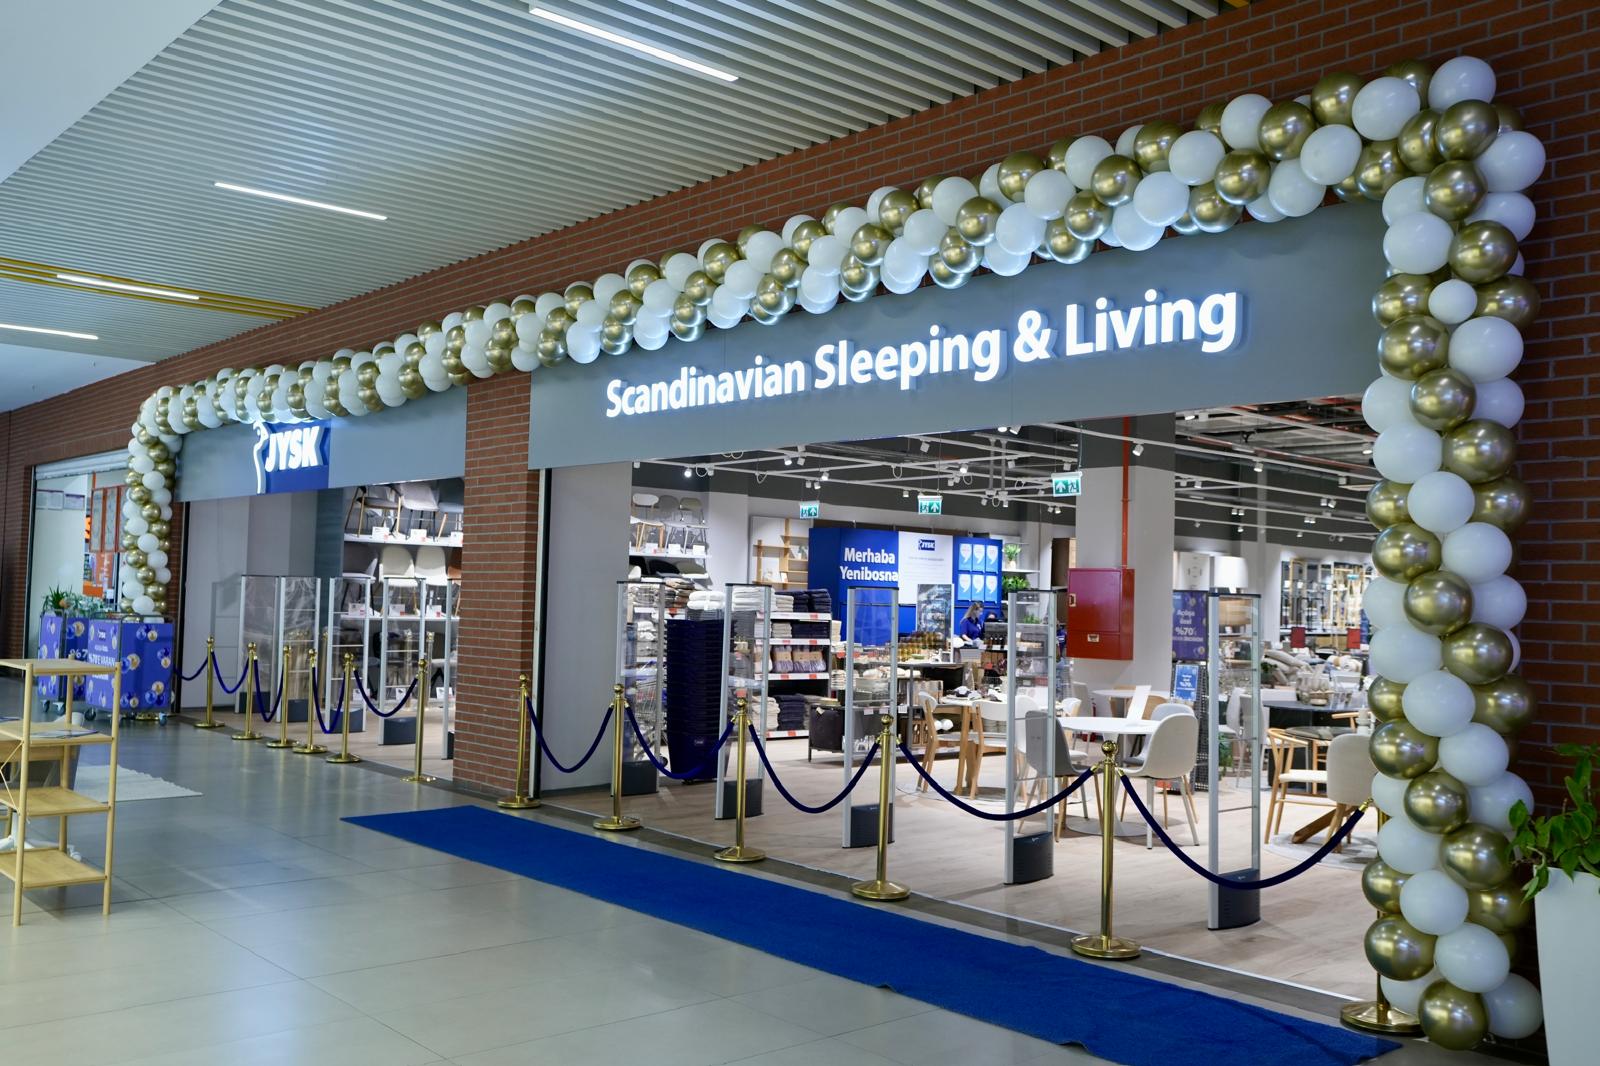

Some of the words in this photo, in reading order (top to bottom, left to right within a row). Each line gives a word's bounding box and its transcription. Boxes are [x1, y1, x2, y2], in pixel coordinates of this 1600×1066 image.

[606, 355, 805, 418] Scandinavian
[814, 324, 1000, 391] Sleeping
[1013, 310, 1050, 363] &
[1066, 288, 1237, 353] Living
[265, 426, 320, 473] JYSK
[844, 547, 896, 564] Merhaba
[840, 566, 899, 582] Yenibosna
